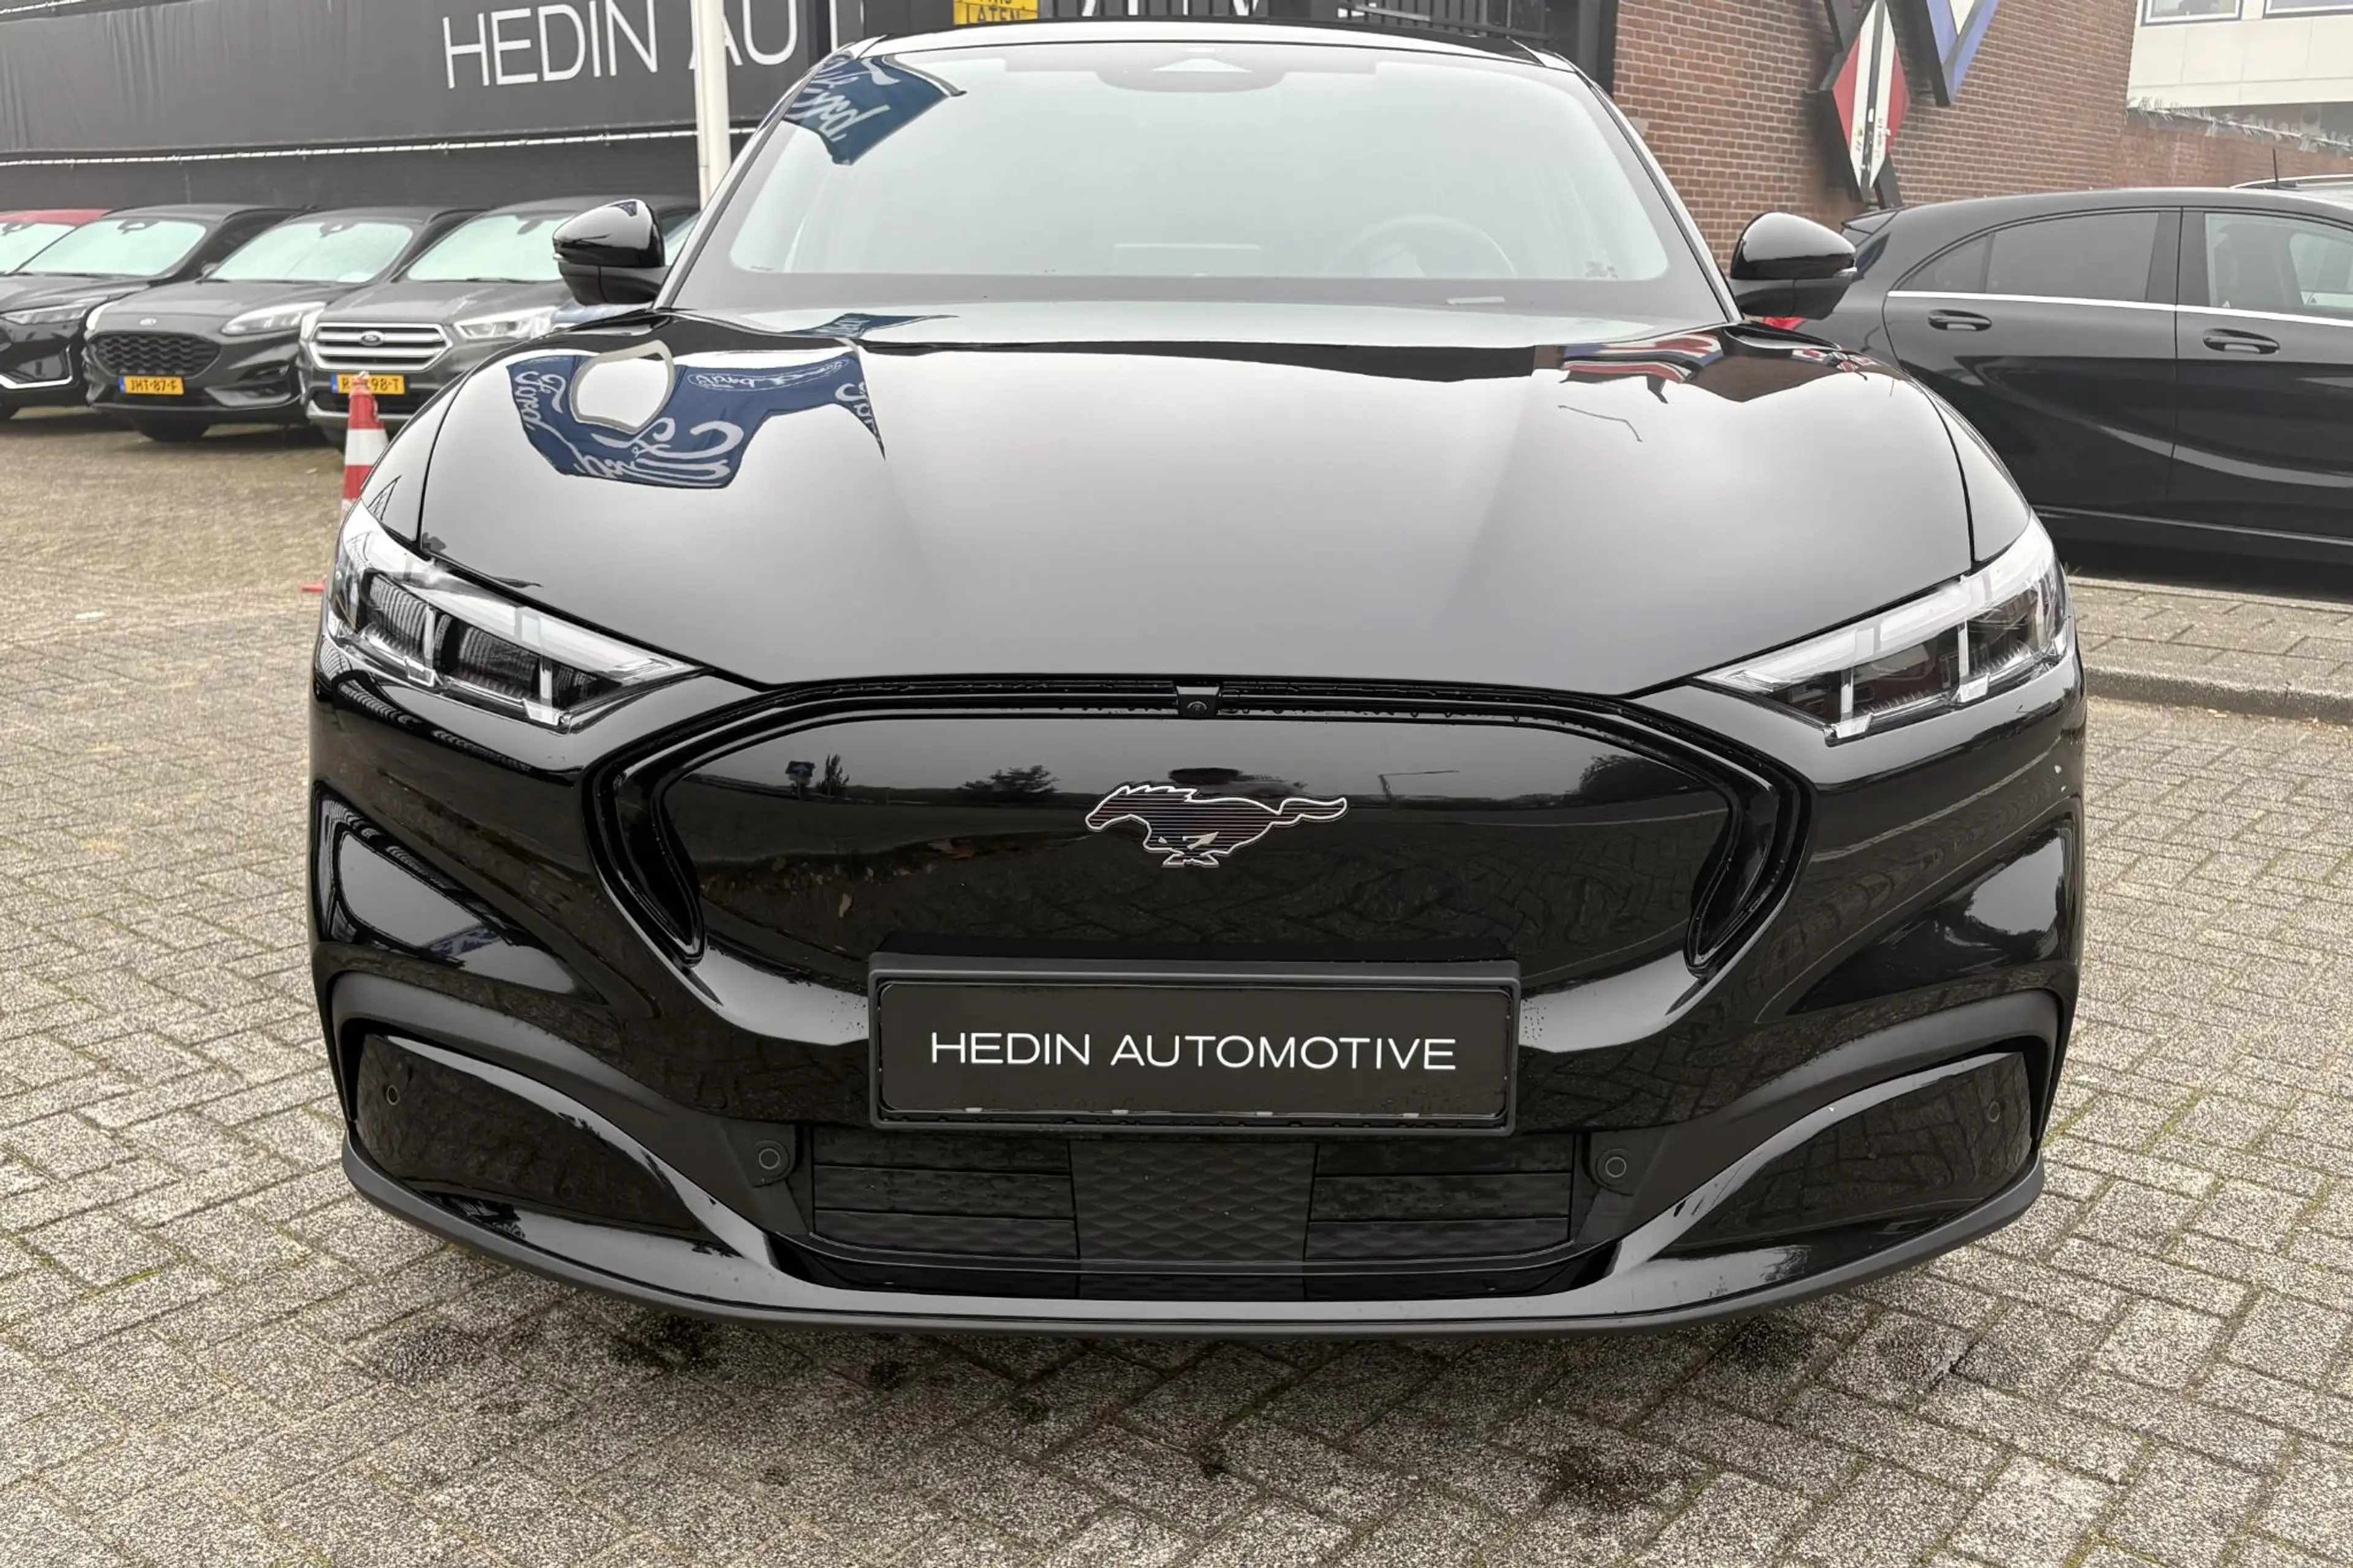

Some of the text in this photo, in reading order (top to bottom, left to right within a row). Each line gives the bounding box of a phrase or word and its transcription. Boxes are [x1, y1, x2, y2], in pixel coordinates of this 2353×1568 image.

[442, 0, 658, 89] HEDIN
[931, 1031, 1457, 1070] HEDIN AUTOMOTIVE
